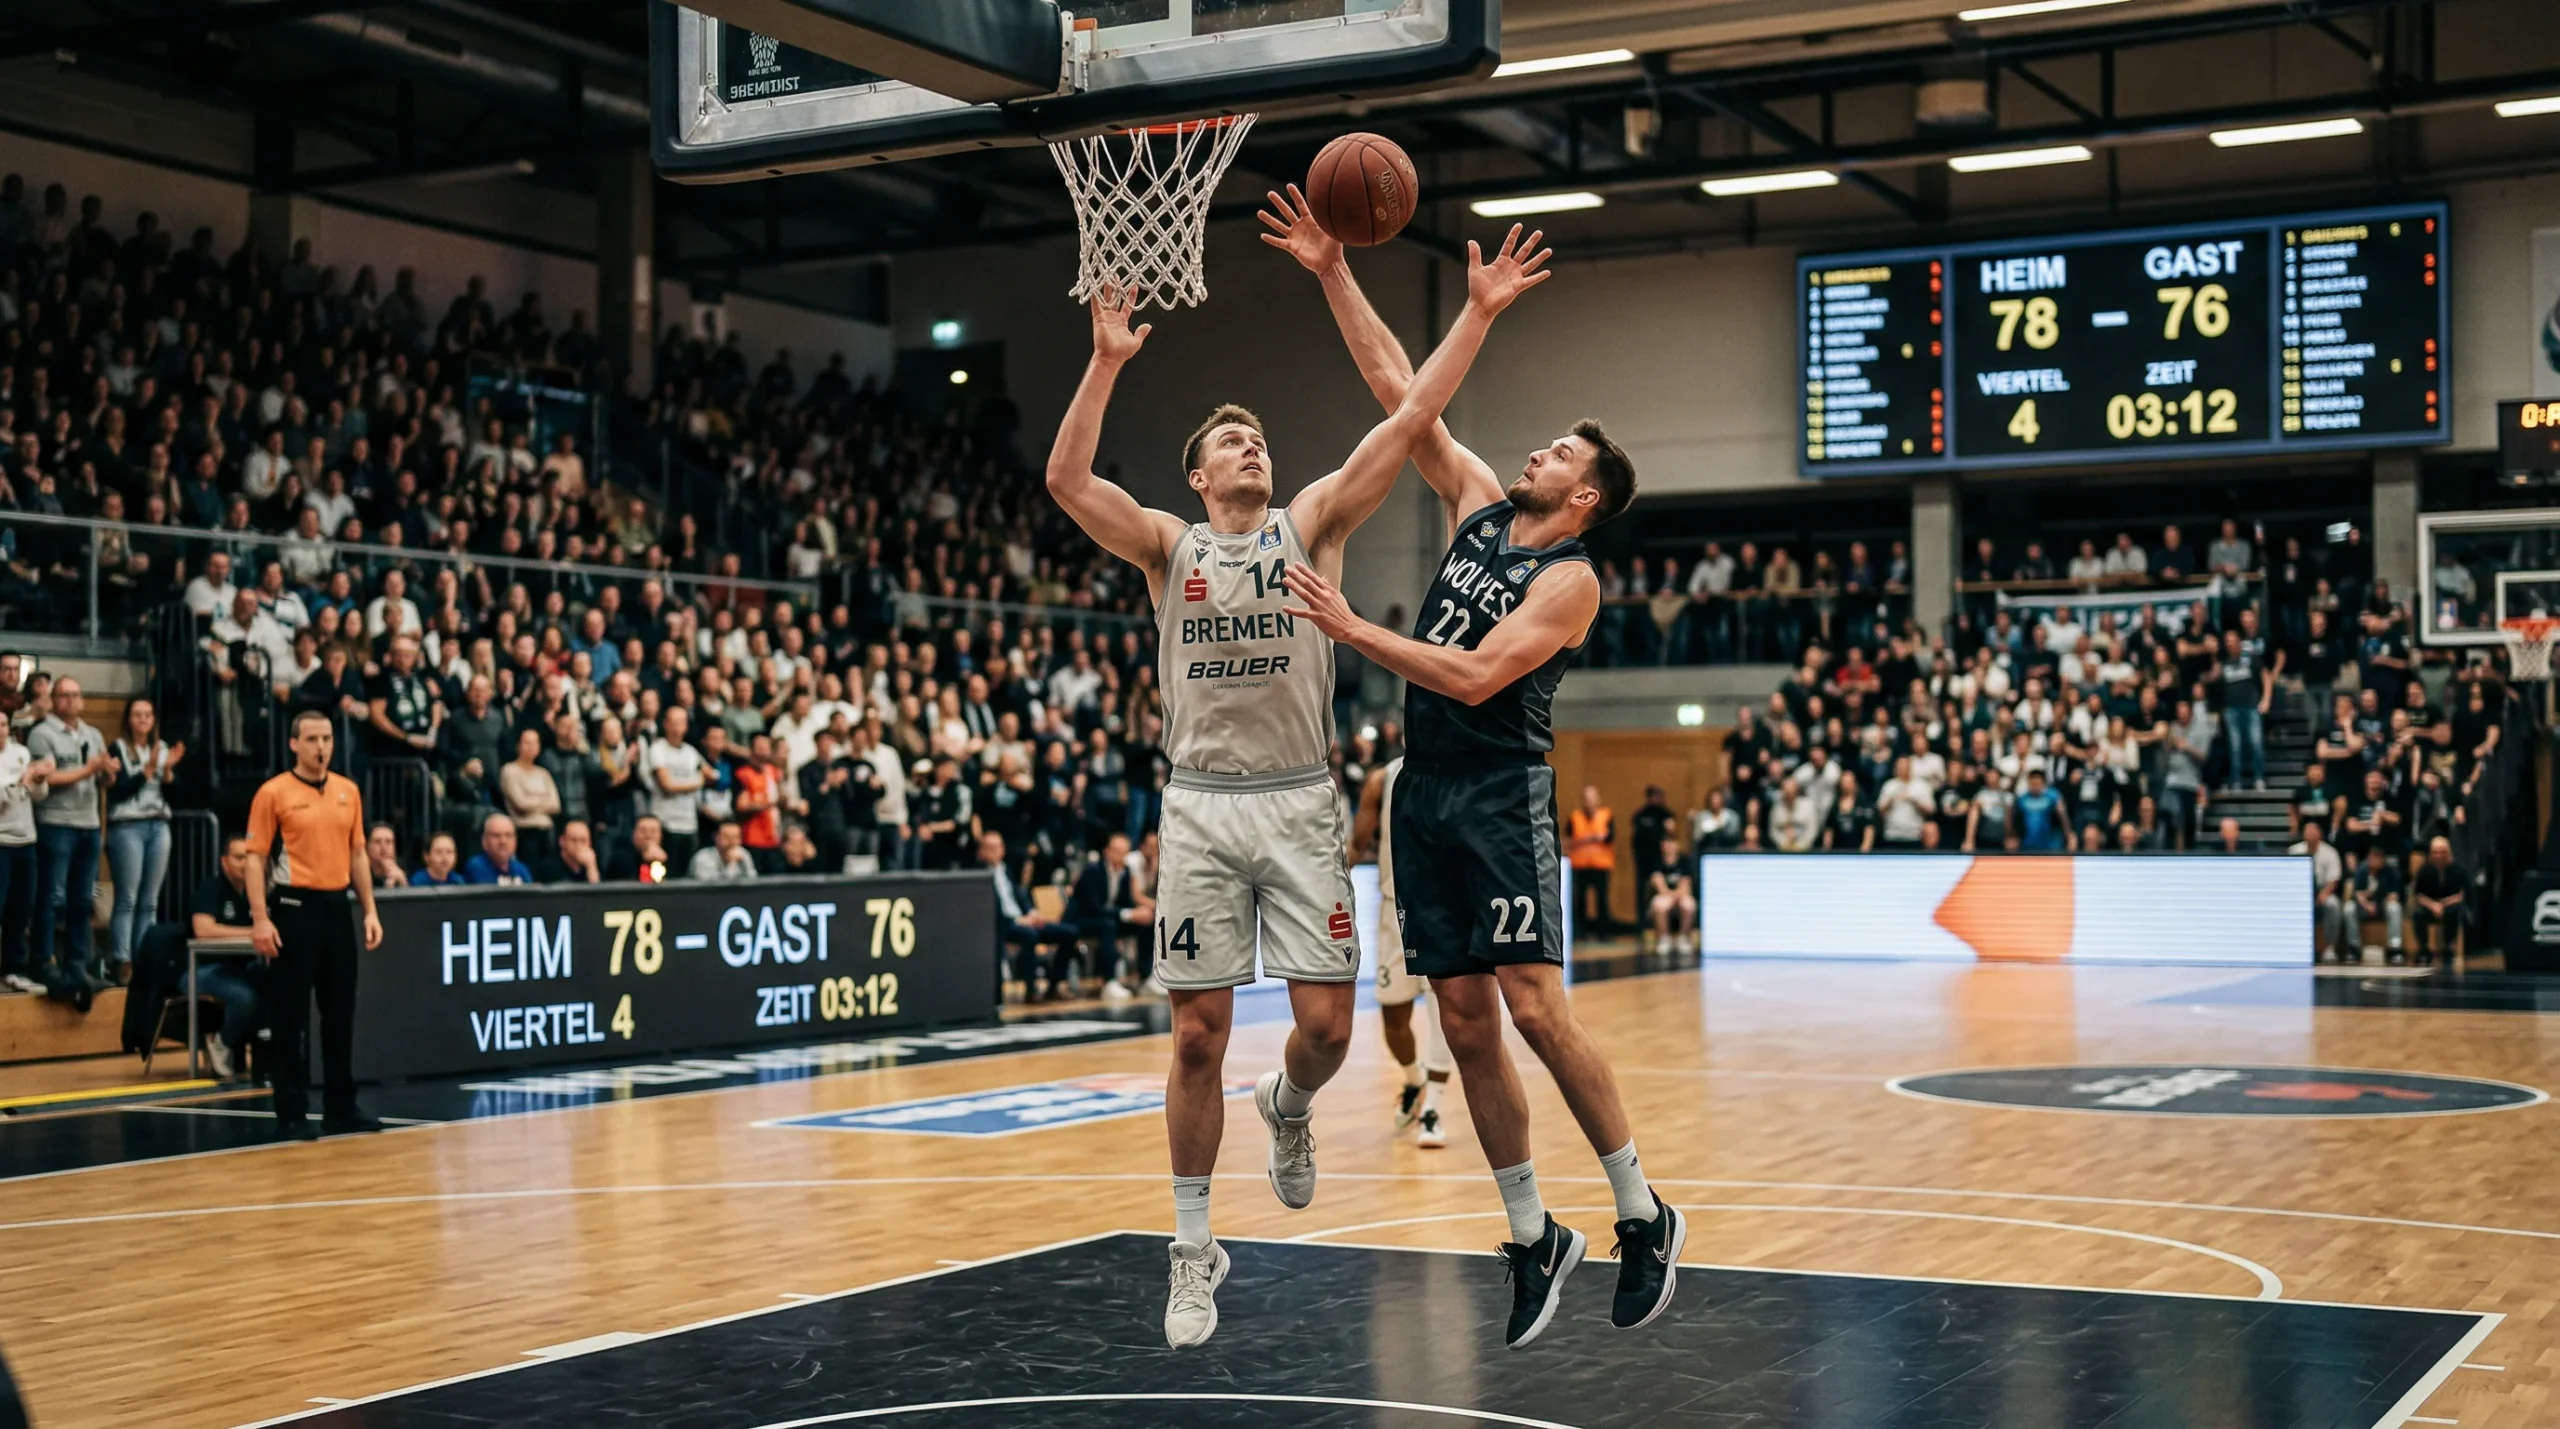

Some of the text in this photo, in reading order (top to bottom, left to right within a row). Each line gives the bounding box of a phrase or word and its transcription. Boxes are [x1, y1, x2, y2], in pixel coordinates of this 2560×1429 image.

[1980, 255, 2067, 293] HEIM
[2143, 241, 2244, 280] GAST
[1989, 297, 2060, 351] 78
[2157, 284, 2230, 340] 76
[1977, 368, 2070, 396] VIERTEL
[2144, 360, 2197, 386] ZEIT
[2007, 399, 2040, 444] 4
[2106, 389, 2238, 439] 03:12
[1246, 558, 1289, 599] 14
[1182, 612, 1295, 645] BREMEN
[1426, 599, 1471, 650] 22
[442, 915, 572, 985] HEIM
[603, 908, 664, 976] 78
[718, 903, 836, 968] GAST
[865, 897, 916, 959] 76
[1159, 916, 1200, 960] 14
[1491, 896, 1537, 943] 22
[755, 972, 899, 1027] ZEIT 03:12
[470, 993, 635, 1053] VIERTEL 4
